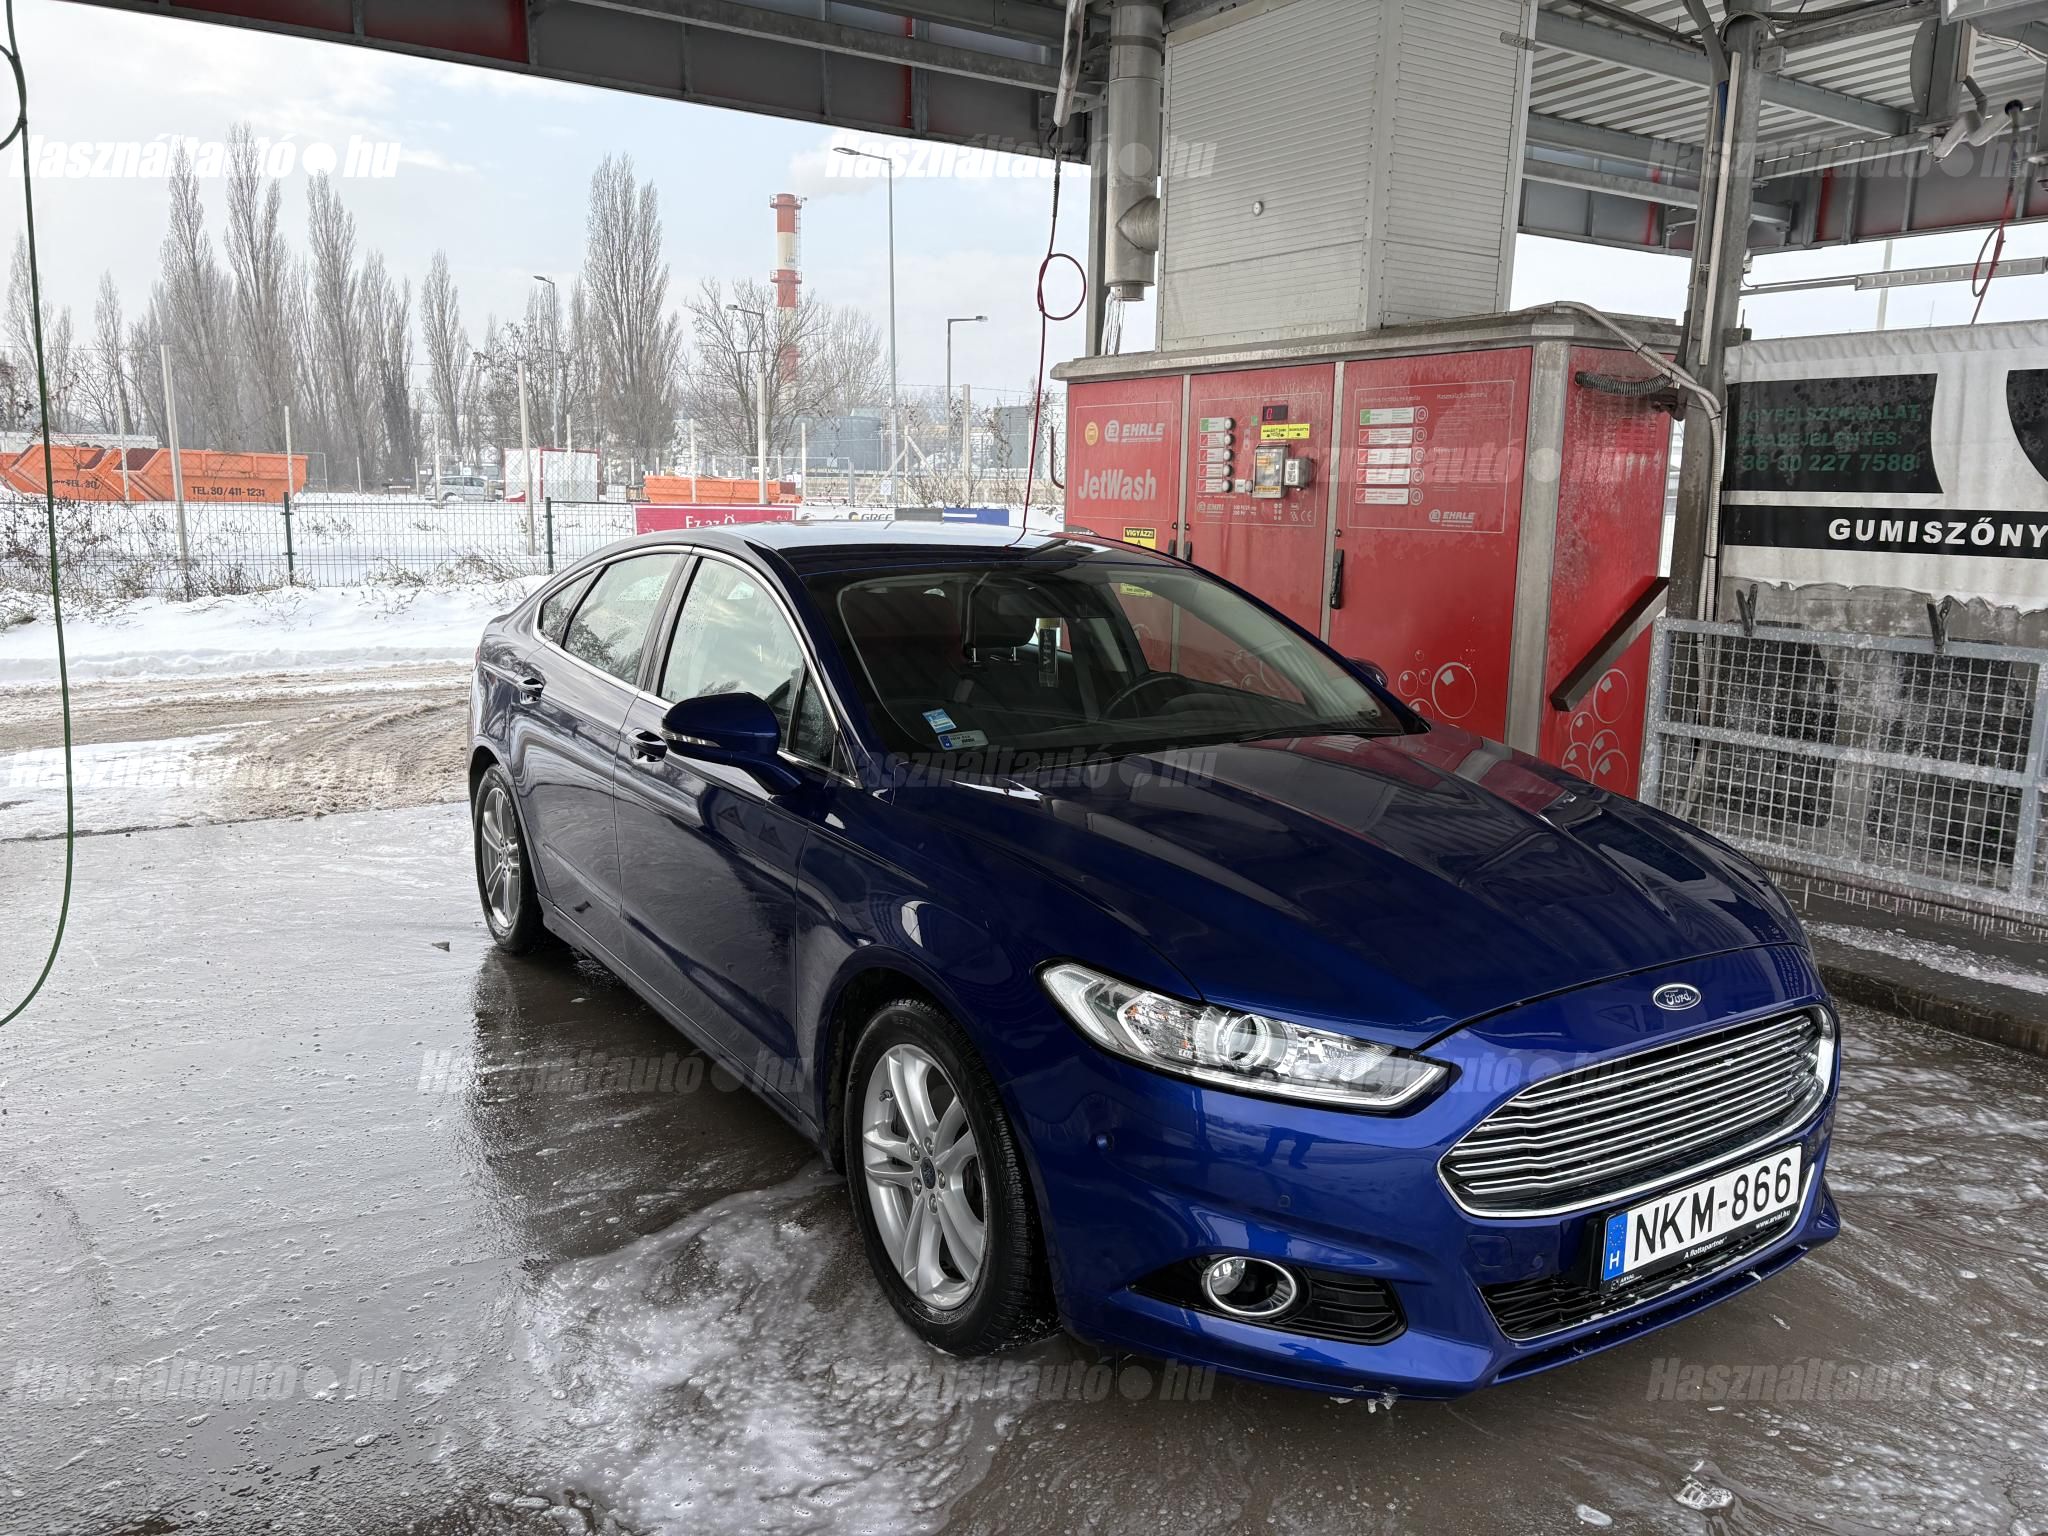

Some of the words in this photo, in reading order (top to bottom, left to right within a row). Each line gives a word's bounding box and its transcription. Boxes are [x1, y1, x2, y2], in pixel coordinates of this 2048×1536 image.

[1808, 453, 1850, 472] 227
[1859, 452, 1916, 472] 7588
[1077, 468, 1157, 500] JetWash
[1828, 517, 2048, 548] GUMISZŐNY
[1664, 988, 1692, 1006] Ford
[1633, 1157, 1792, 1262] NKM-866
[1608, 1250, 1621, 1270] H
